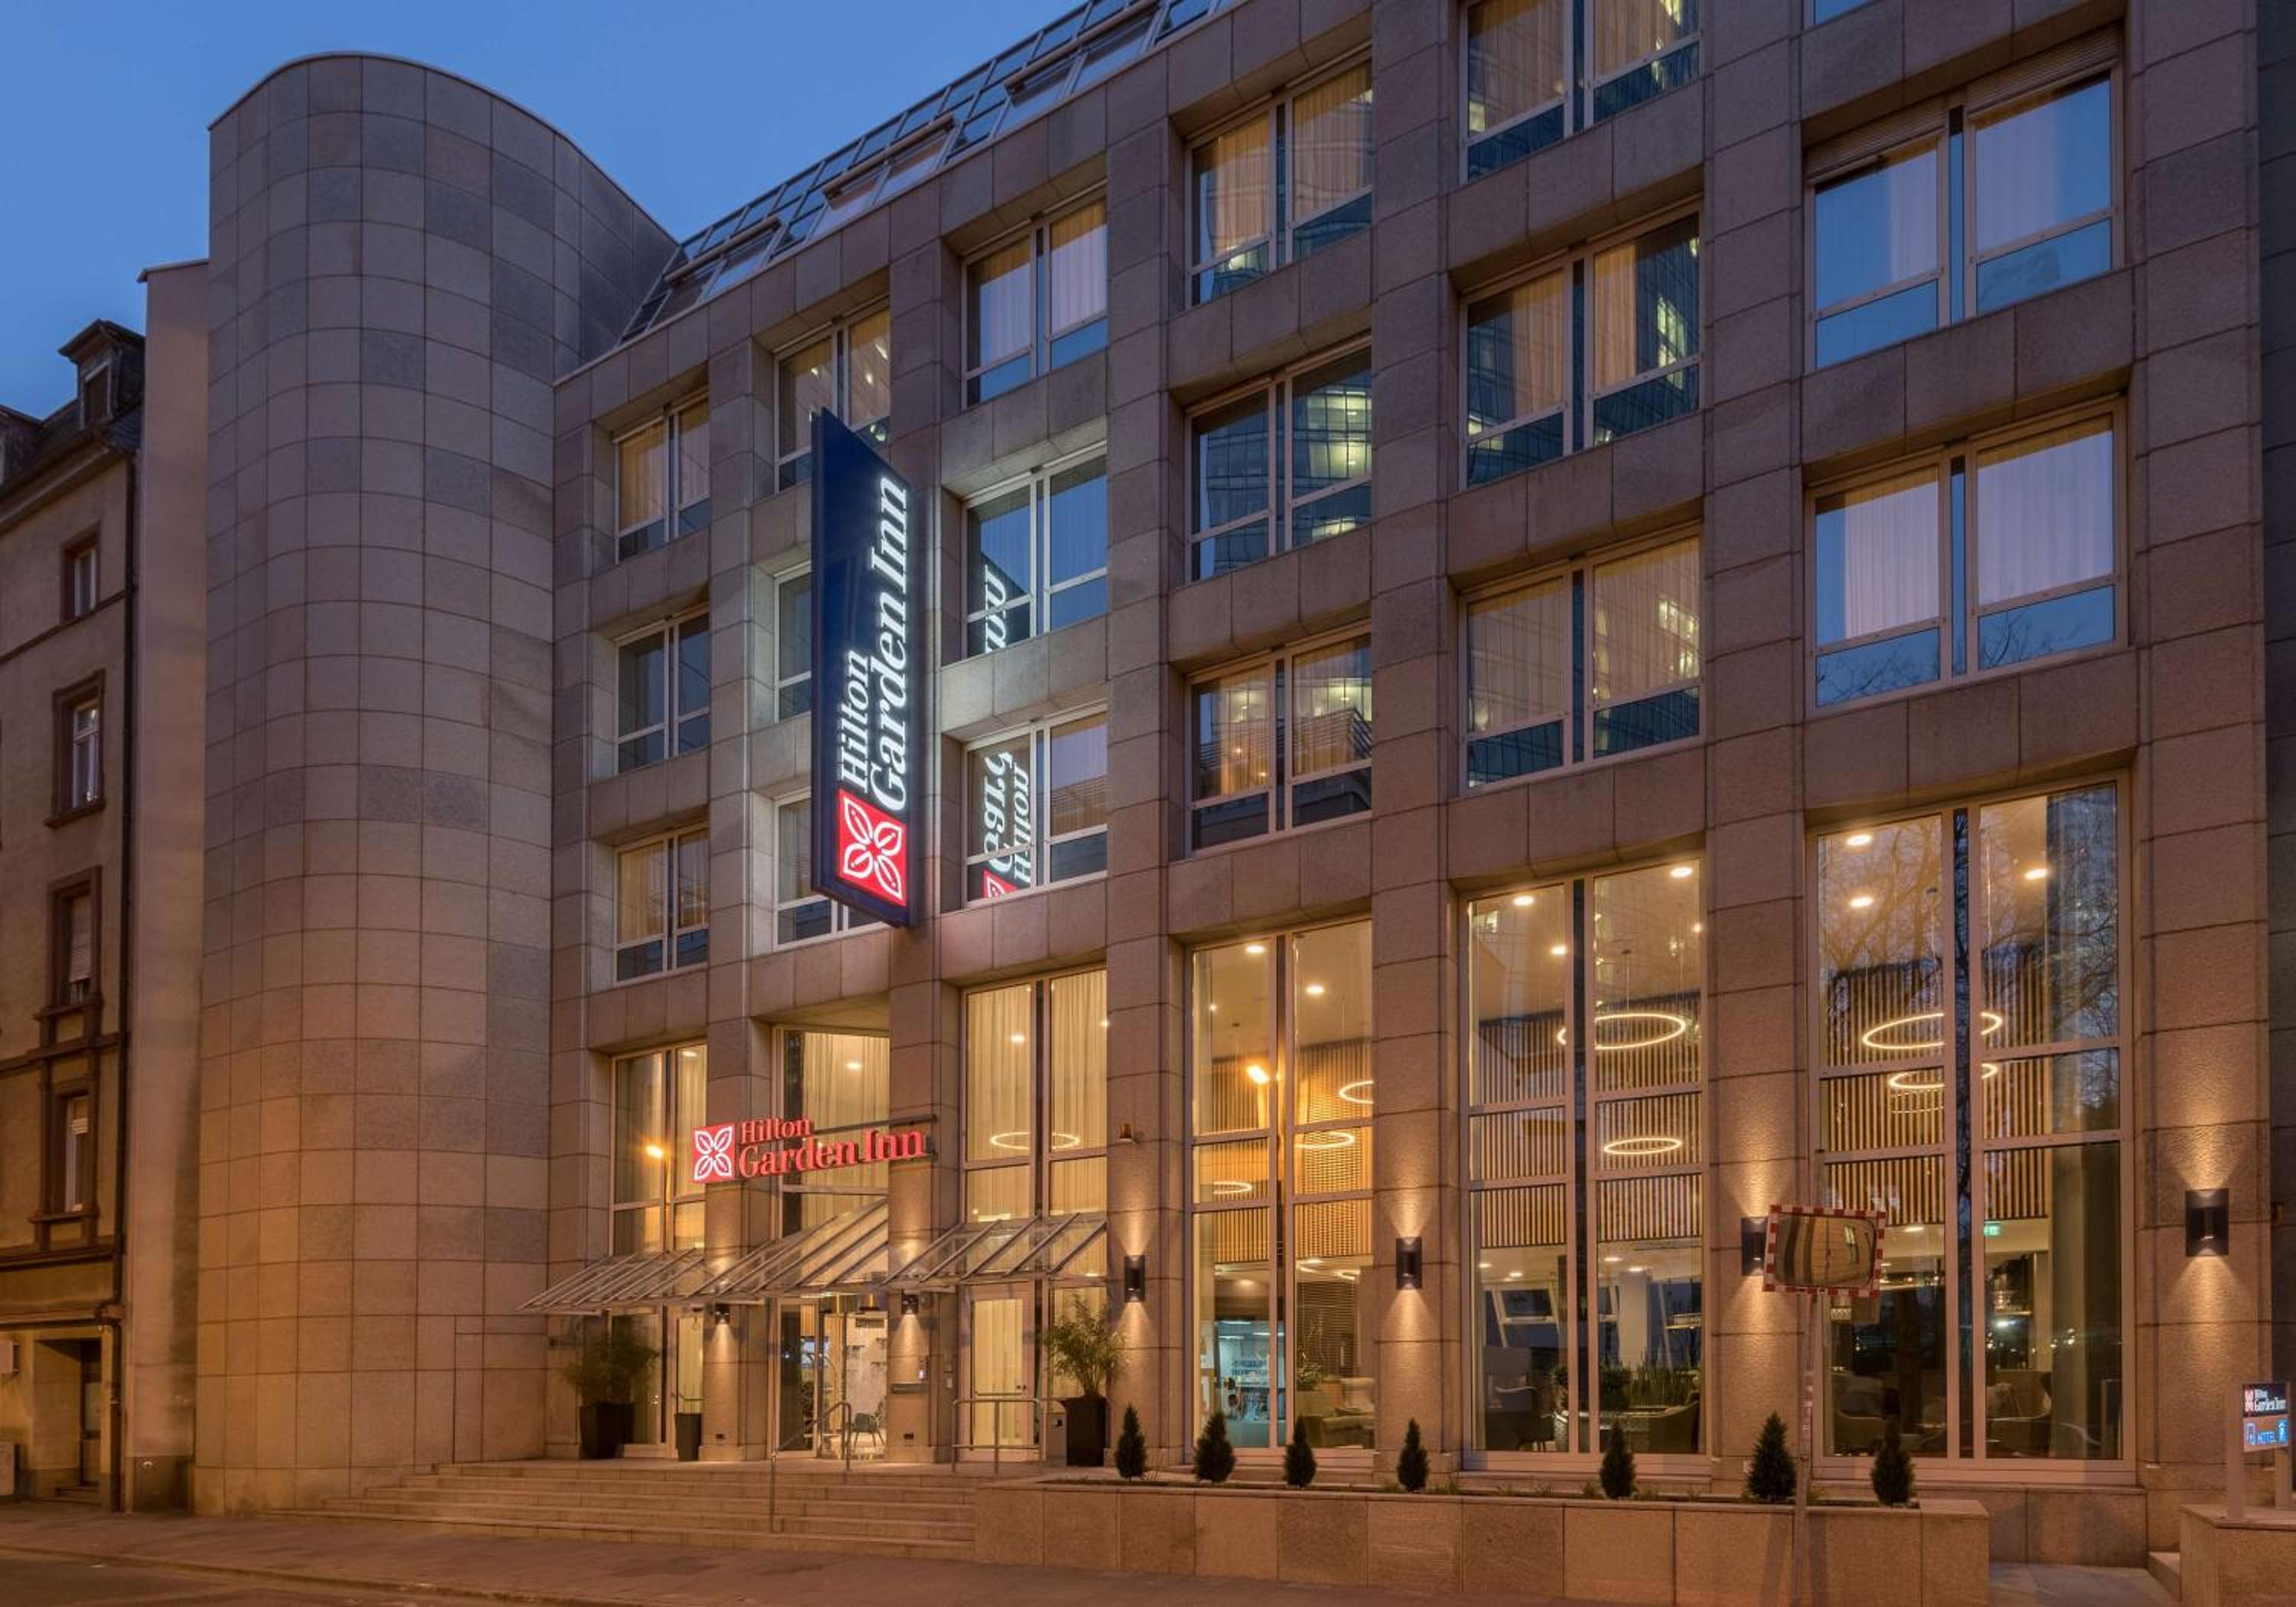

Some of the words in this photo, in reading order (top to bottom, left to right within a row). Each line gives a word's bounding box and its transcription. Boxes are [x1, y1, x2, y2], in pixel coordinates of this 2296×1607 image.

[871, 477, 907, 595] Inn
[840, 650, 869, 794] Hilton
[870, 592, 907, 811] Garden
[739, 1137, 856, 1178] Garden
[862, 1129, 925, 1161] Inn
[741, 1117, 812, 1145] Hilton
